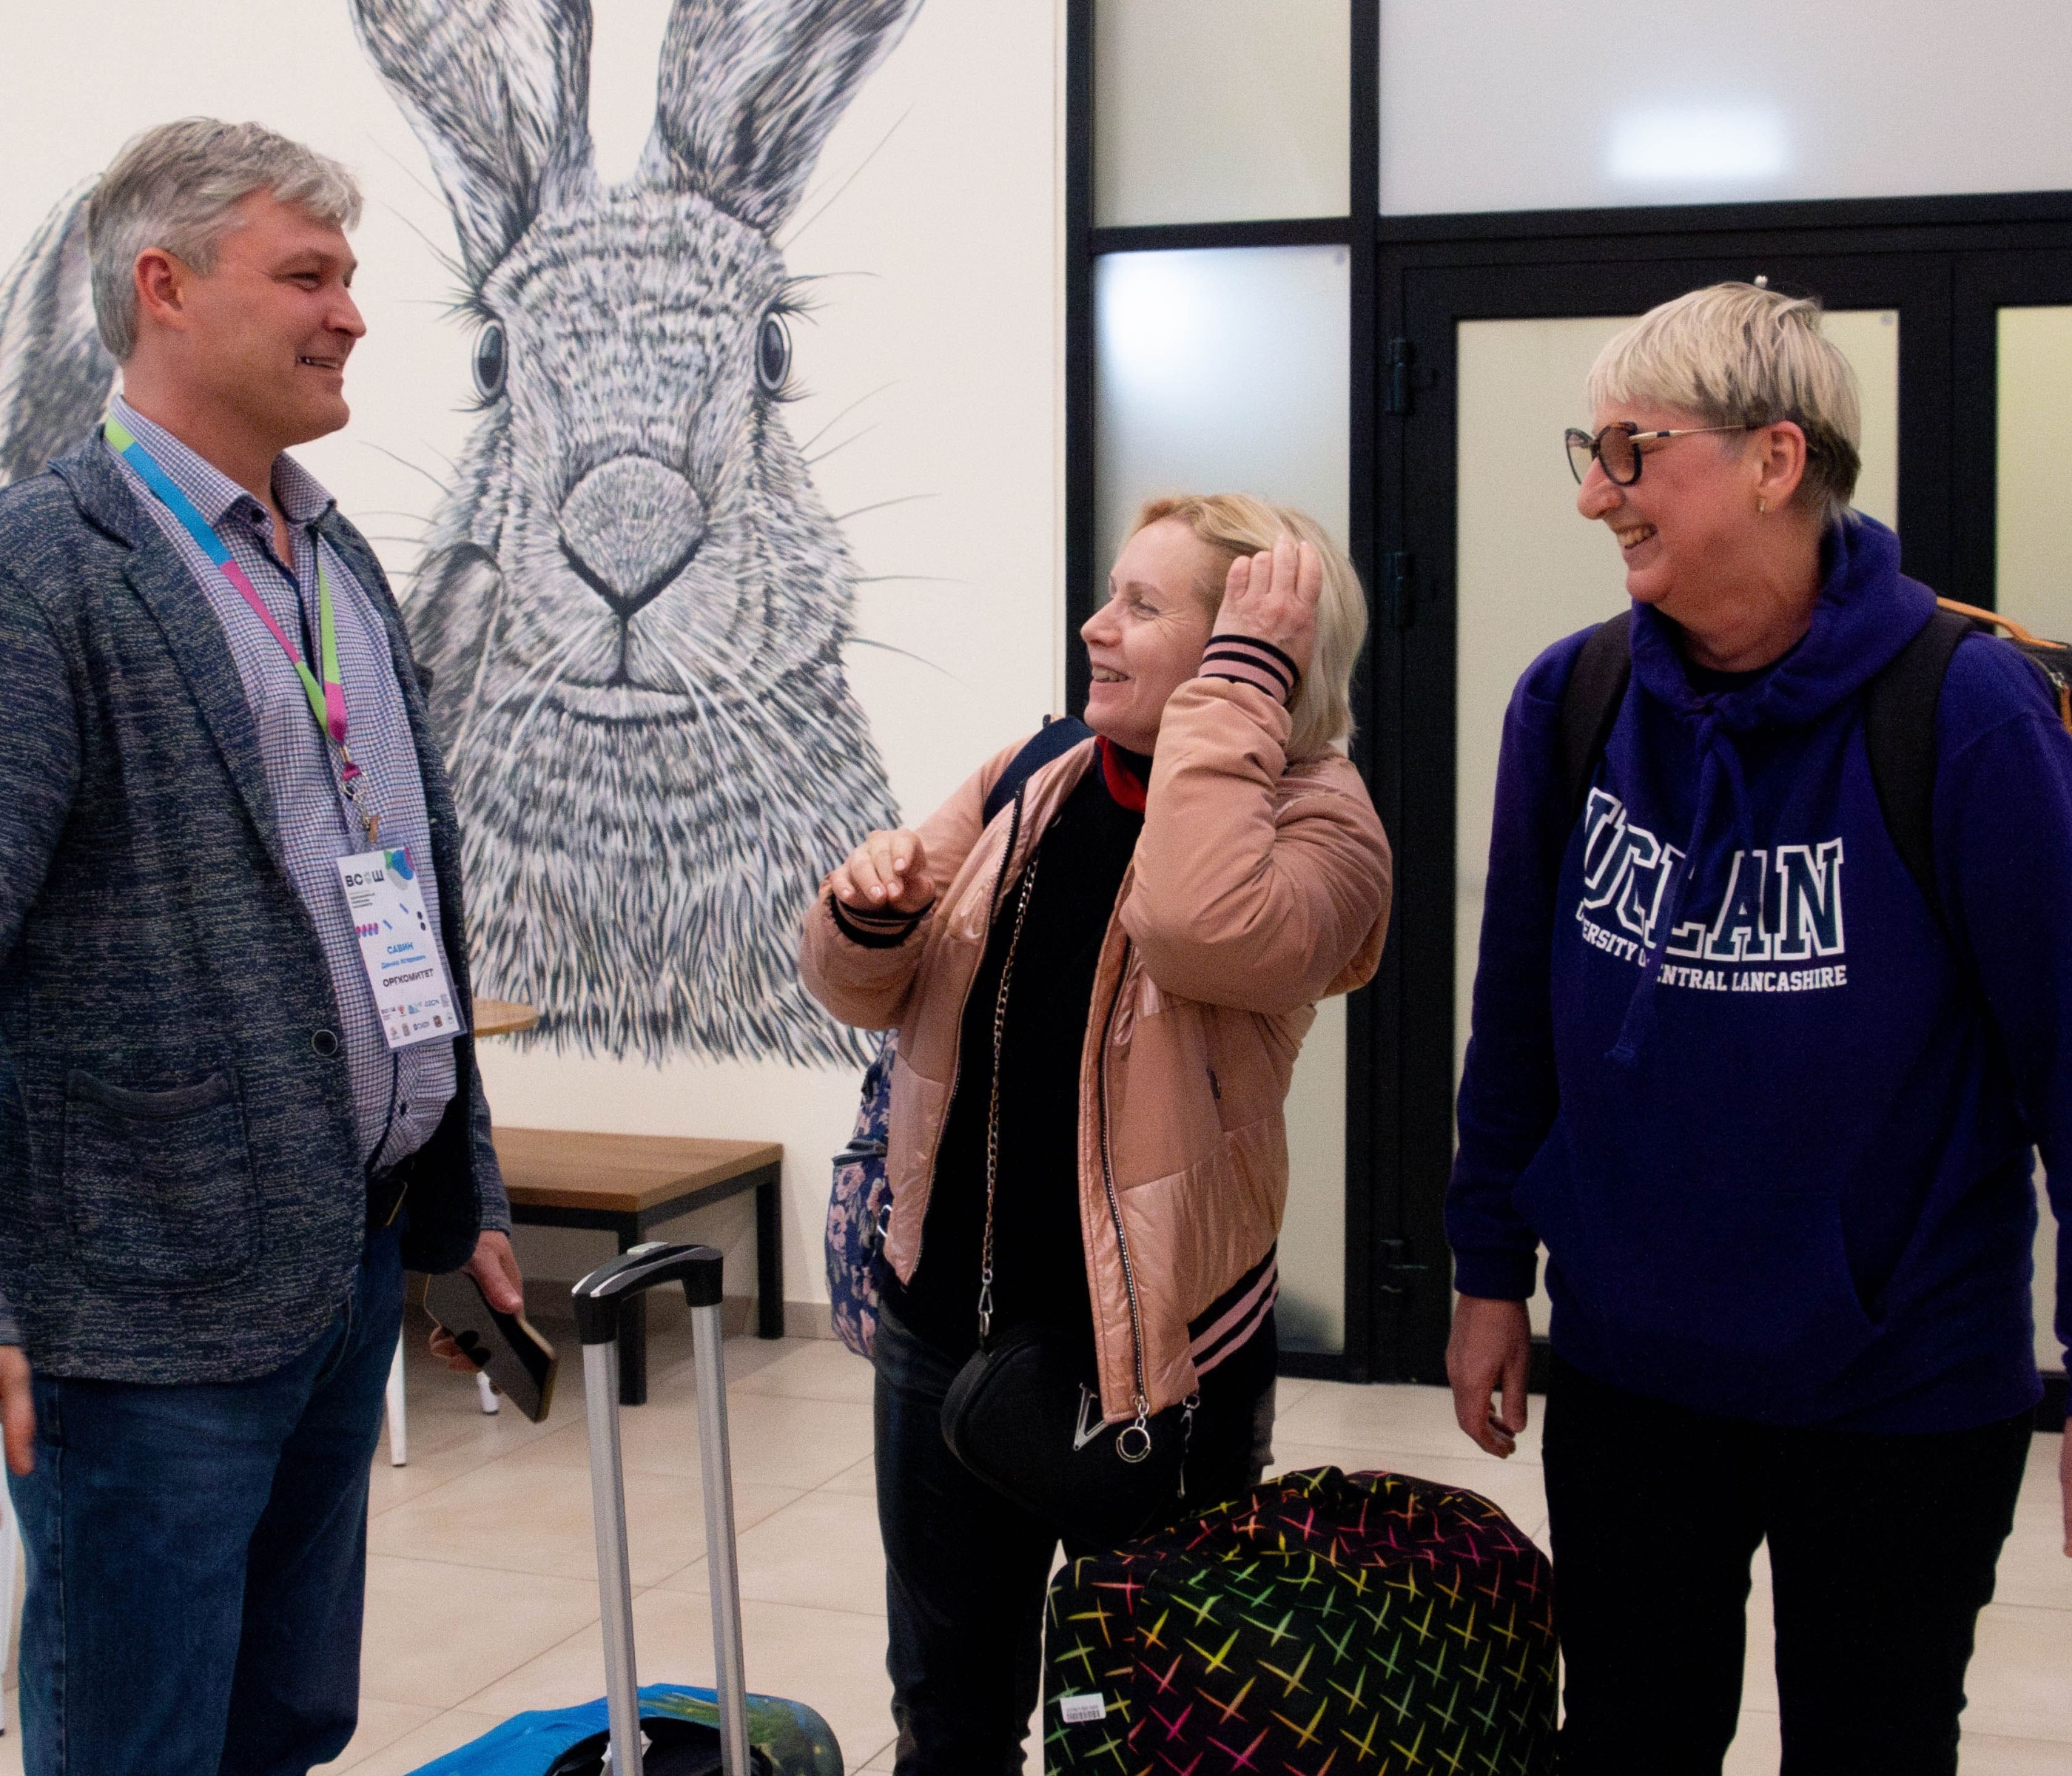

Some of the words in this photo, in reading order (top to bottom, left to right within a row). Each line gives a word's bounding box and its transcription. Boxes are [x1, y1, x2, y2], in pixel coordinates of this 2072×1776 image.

[387, 941, 414, 955] САВИН
[383, 968, 434, 987] ОРГКОМИТЕТ
[1731, 965, 1848, 992] LANCASHIRE
